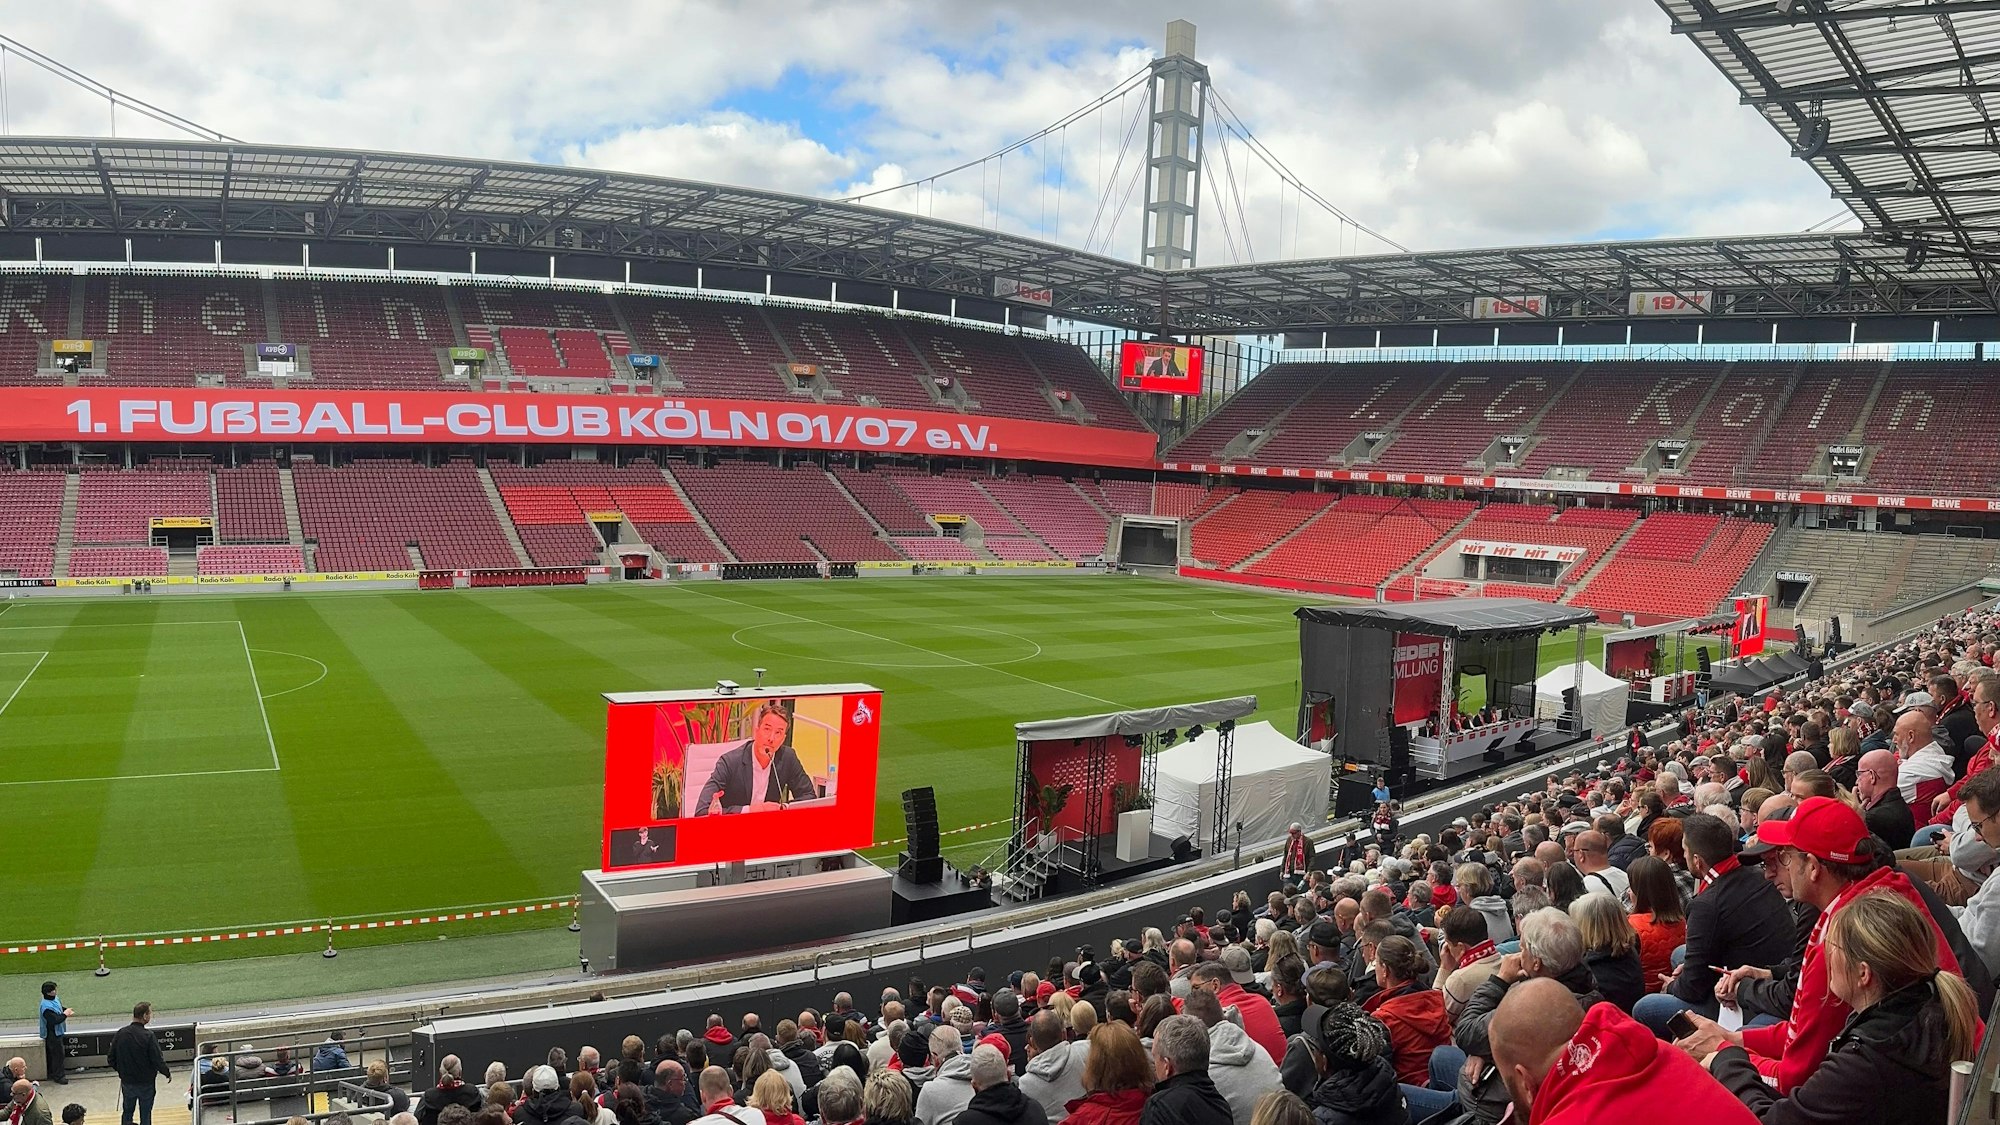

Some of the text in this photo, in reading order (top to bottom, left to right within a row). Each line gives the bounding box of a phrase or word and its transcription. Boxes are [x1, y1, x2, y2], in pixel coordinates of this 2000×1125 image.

[1419, 376, 1547, 421] FC
[1626, 377, 1936, 430] Köln
[67, 399, 107, 433] 1.
[618, 401, 769, 441] KÖLN
[777, 413, 916, 446] 01/07
[926, 424, 996, 451] e.V.
[1250, 467, 1267, 475] REWE
[1316, 470, 1333, 478] REWE
[1350, 472, 1369, 480] REWE
[1386, 474, 1406, 482] REWE
[1424, 476, 1444, 484] REWE
[1463, 477, 1484, 486] REWE
[1631, 485, 1656, 494] REWE
[1678, 488, 1704, 496] REWE
[1726, 490, 1751, 499] REWE
[1775, 492, 1801, 502] REWE
[1825, 494, 1852, 503] REWE
[1878, 496, 1906, 506] REWE
[1932, 498, 1960, 508] REWE
[1463, 544, 1580, 560] HIT HIT HIT HIT
[1777, 572, 1794, 580] Gaffel
